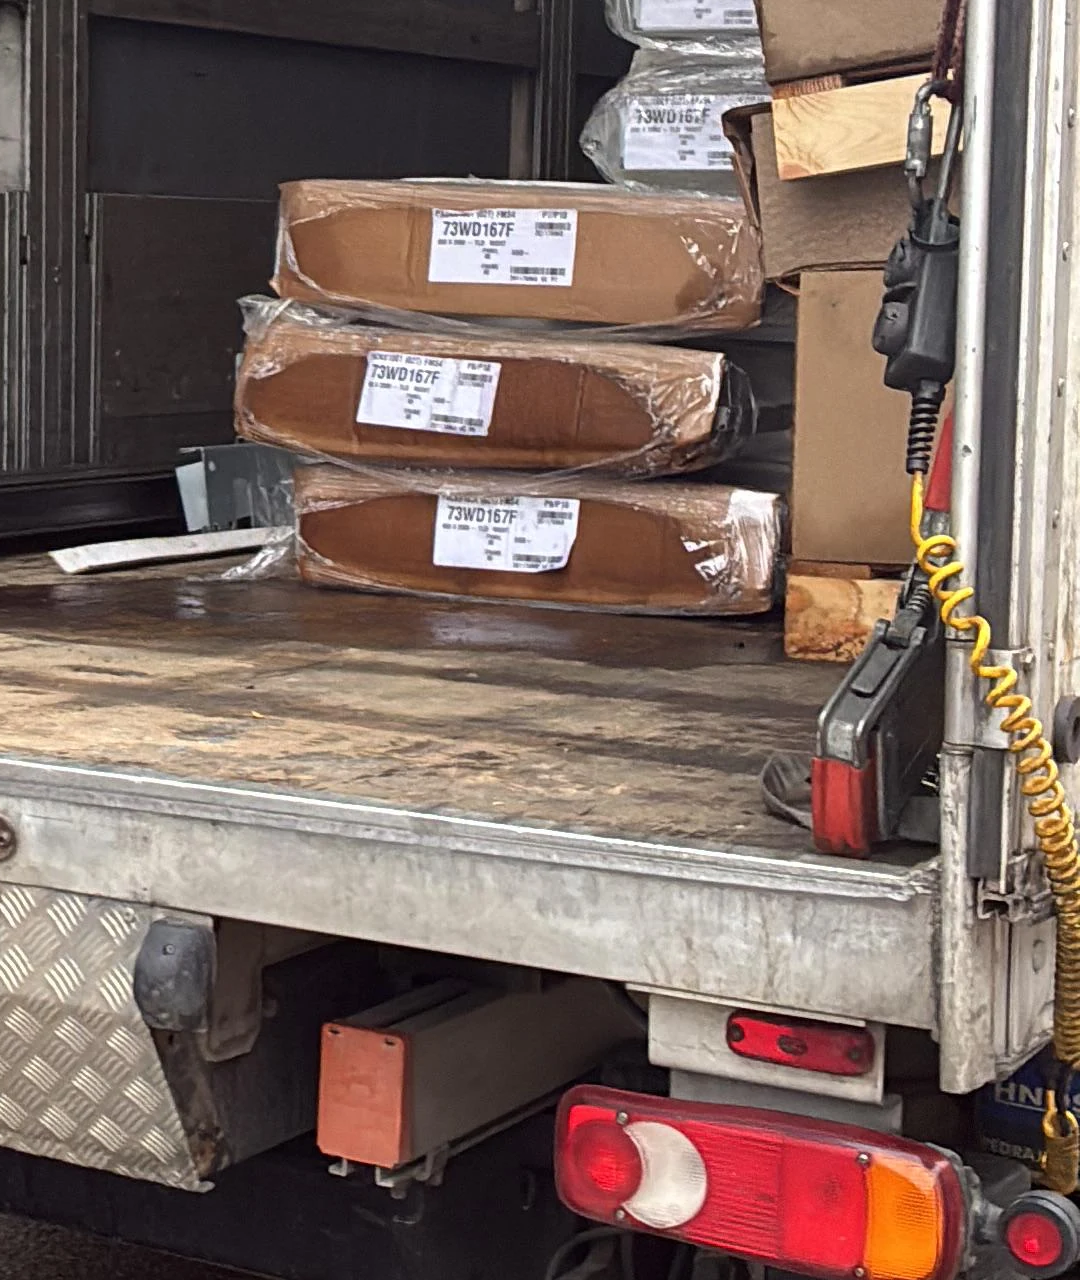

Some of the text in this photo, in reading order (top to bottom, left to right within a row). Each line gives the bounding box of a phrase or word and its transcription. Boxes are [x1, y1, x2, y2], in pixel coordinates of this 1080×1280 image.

[443, 221, 515, 238] 73WD167F
[371, 364, 440, 385] 73WD167F
[447, 505, 518, 524] 73WD167F
